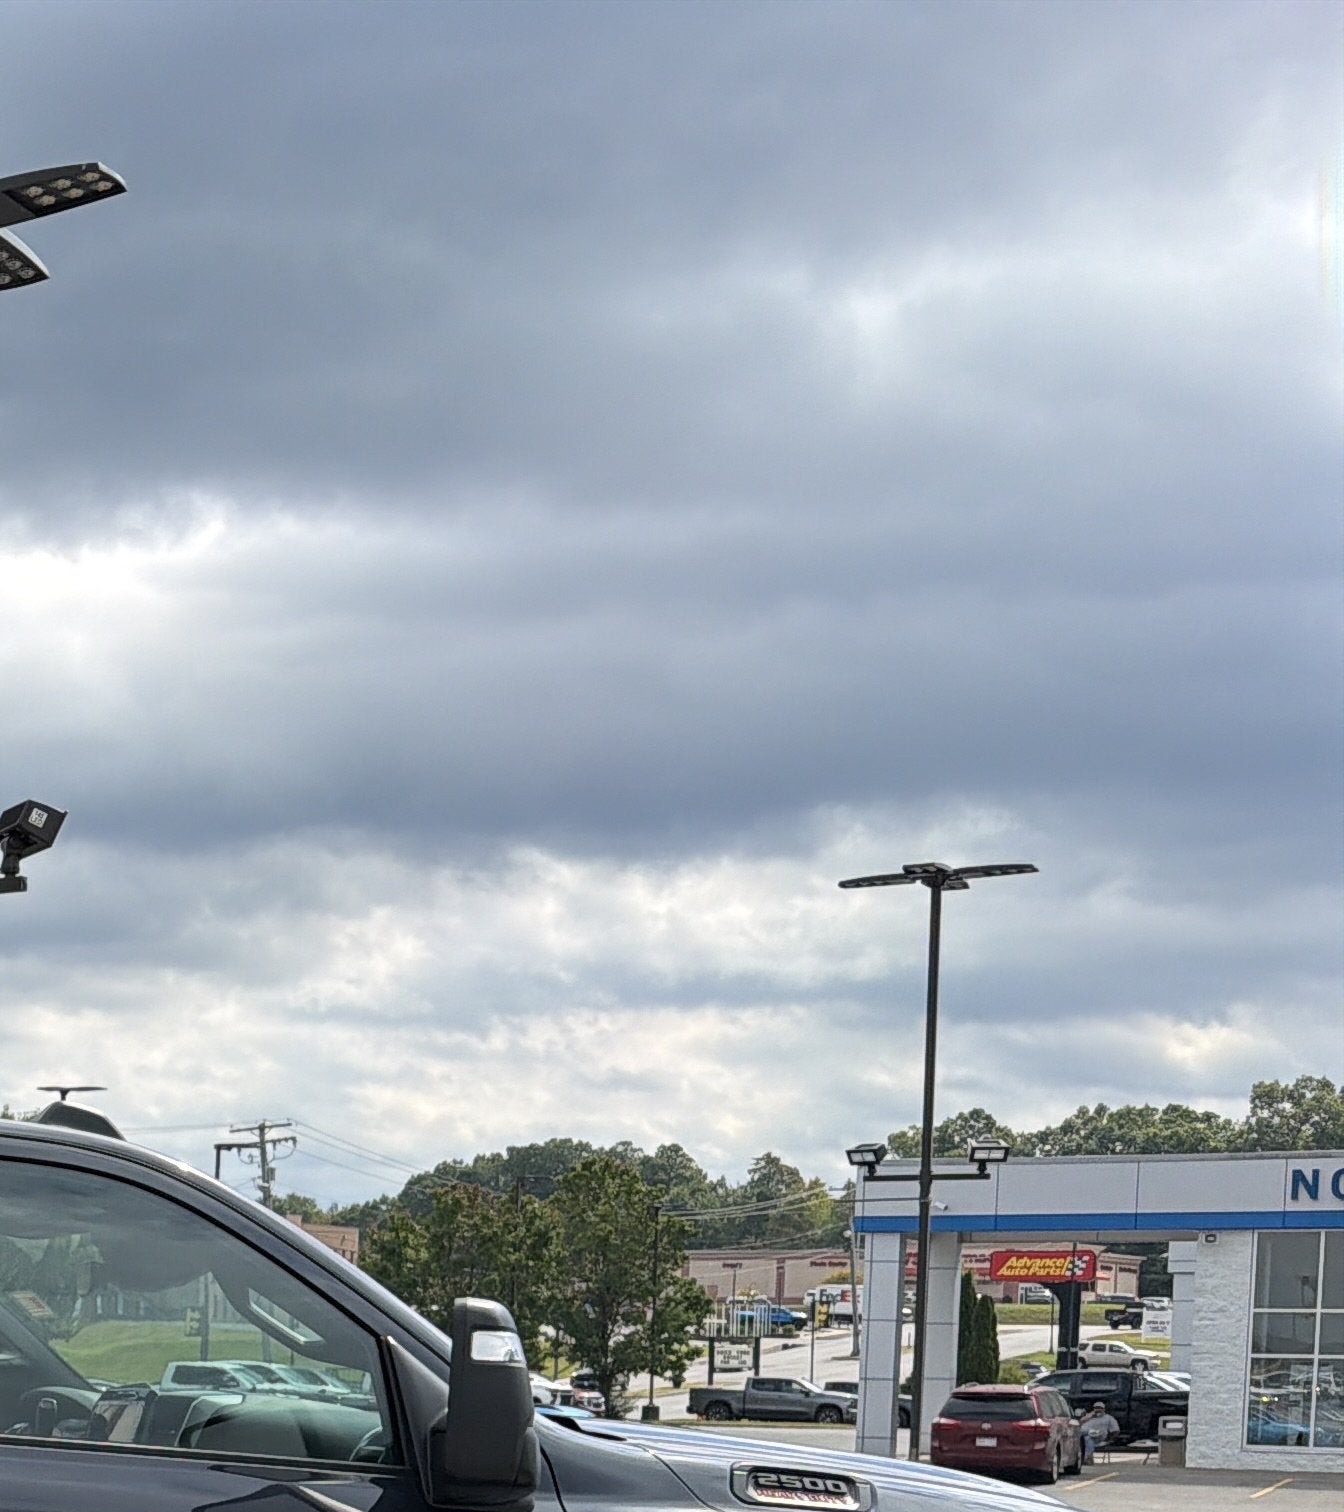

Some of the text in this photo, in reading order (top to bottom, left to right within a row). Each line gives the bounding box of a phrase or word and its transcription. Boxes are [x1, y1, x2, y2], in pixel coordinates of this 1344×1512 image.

[1006, 1256, 1065, 1268] Advance
[997, 1266, 1064, 1277] Auto Parts
[756, 1472, 848, 1493] 2500
